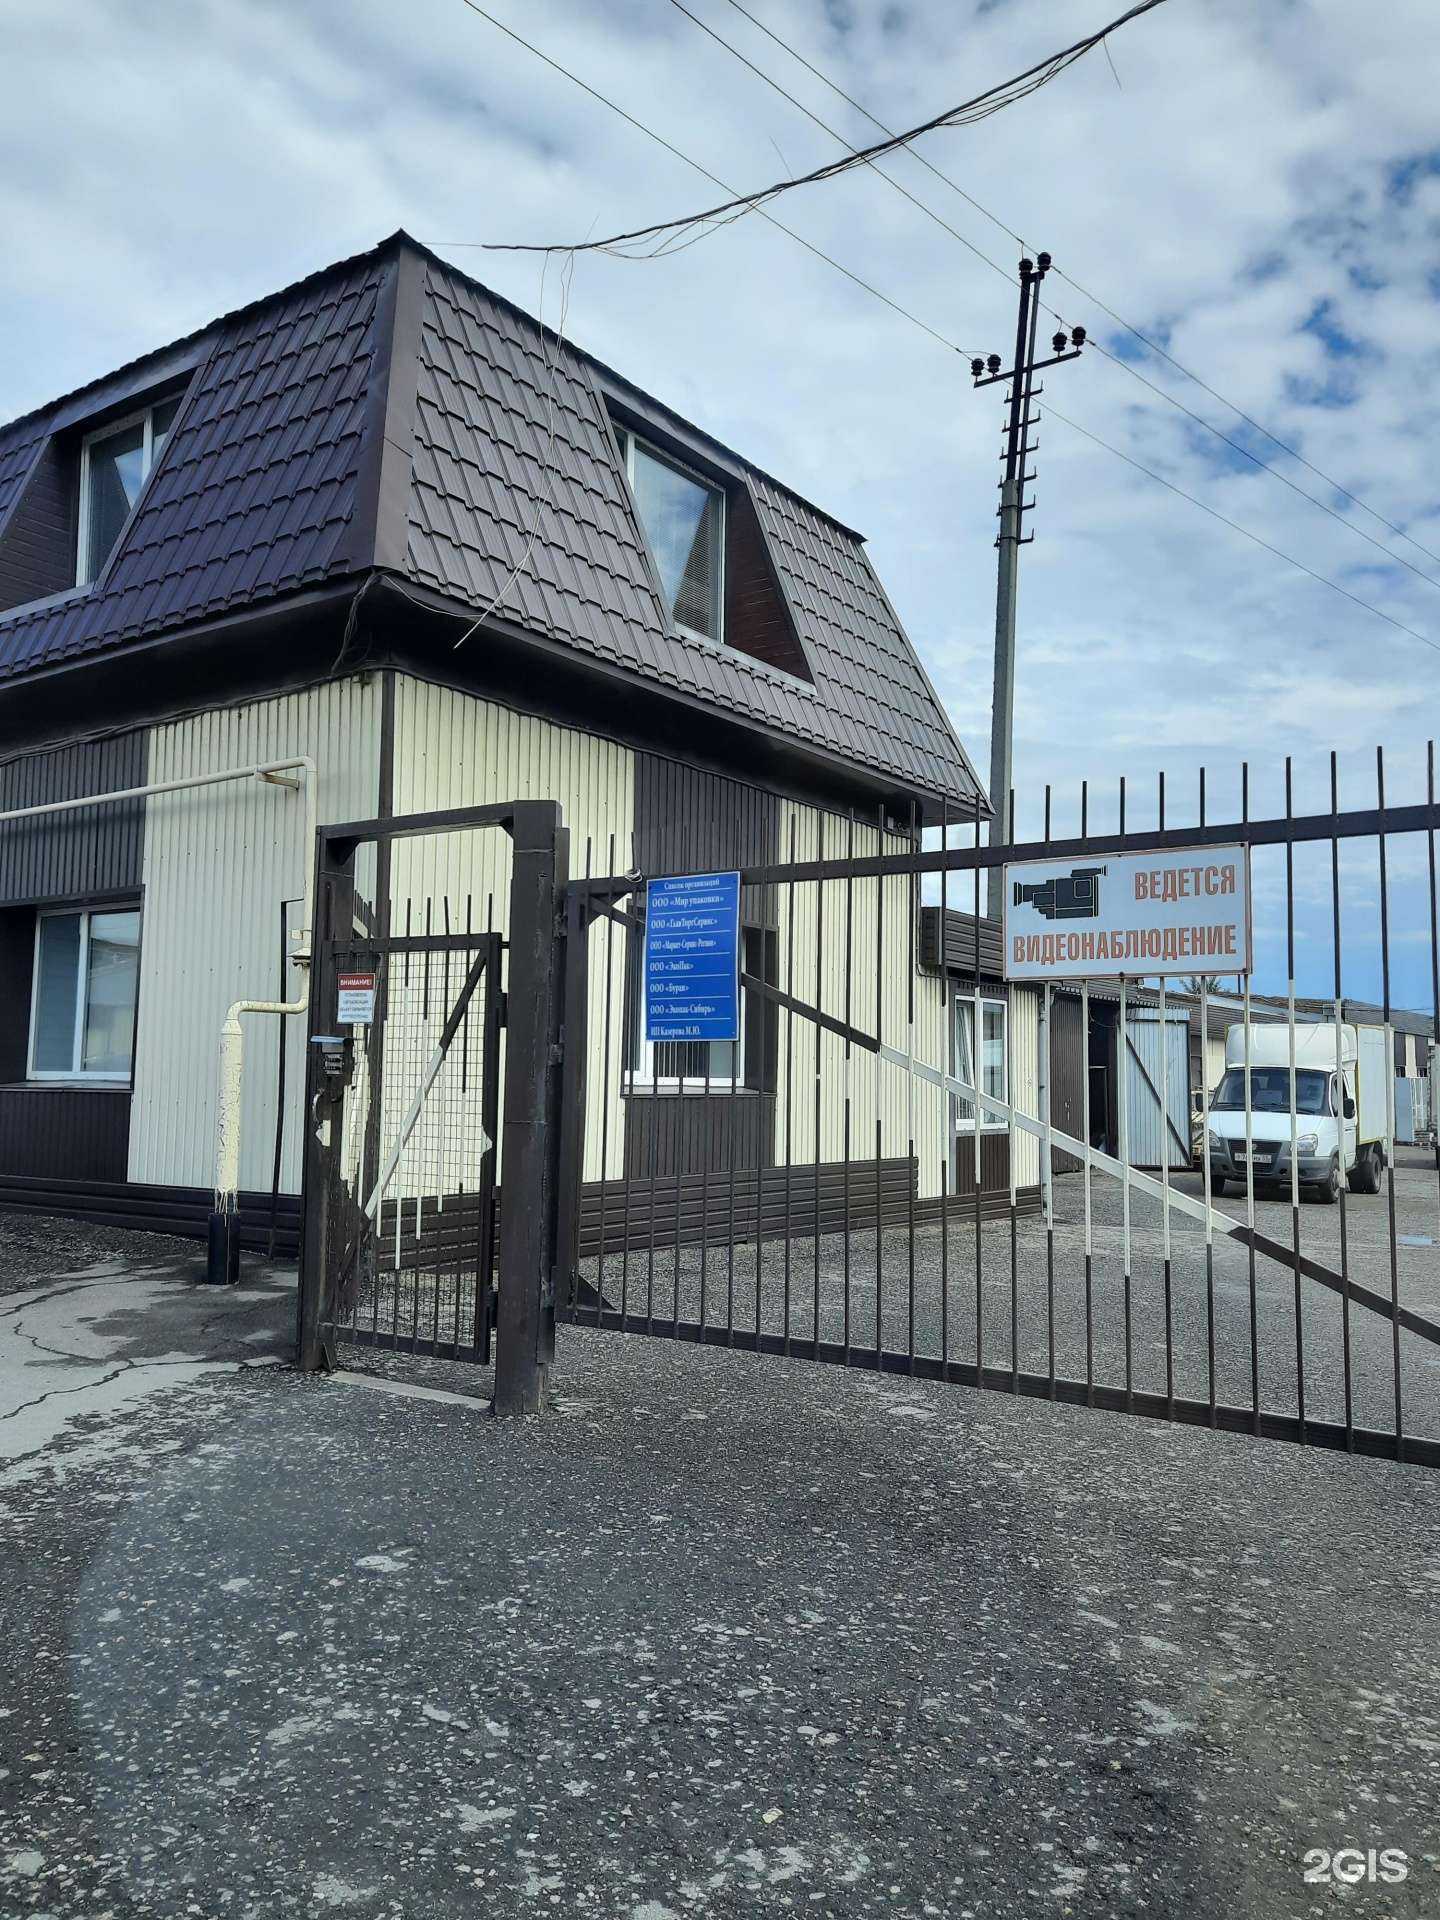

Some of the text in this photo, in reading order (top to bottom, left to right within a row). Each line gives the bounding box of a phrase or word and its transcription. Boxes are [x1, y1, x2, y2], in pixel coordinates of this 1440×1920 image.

[1134, 864, 1235, 902] ВЕДЕТСЯ
[652, 897, 669, 908] ООО
[651, 919, 666, 929] ООО
[650, 940, 662, 950] ООО
[1012, 924, 1237, 965] ВИДЕОНАБЛЮДЕНИЕ
[650, 961, 665, 971] ООО
[340, 978, 372, 986] ВНИМАНИЕ!
[650, 983, 665, 993] ООО
[650, 1005, 665, 1015] ООО
